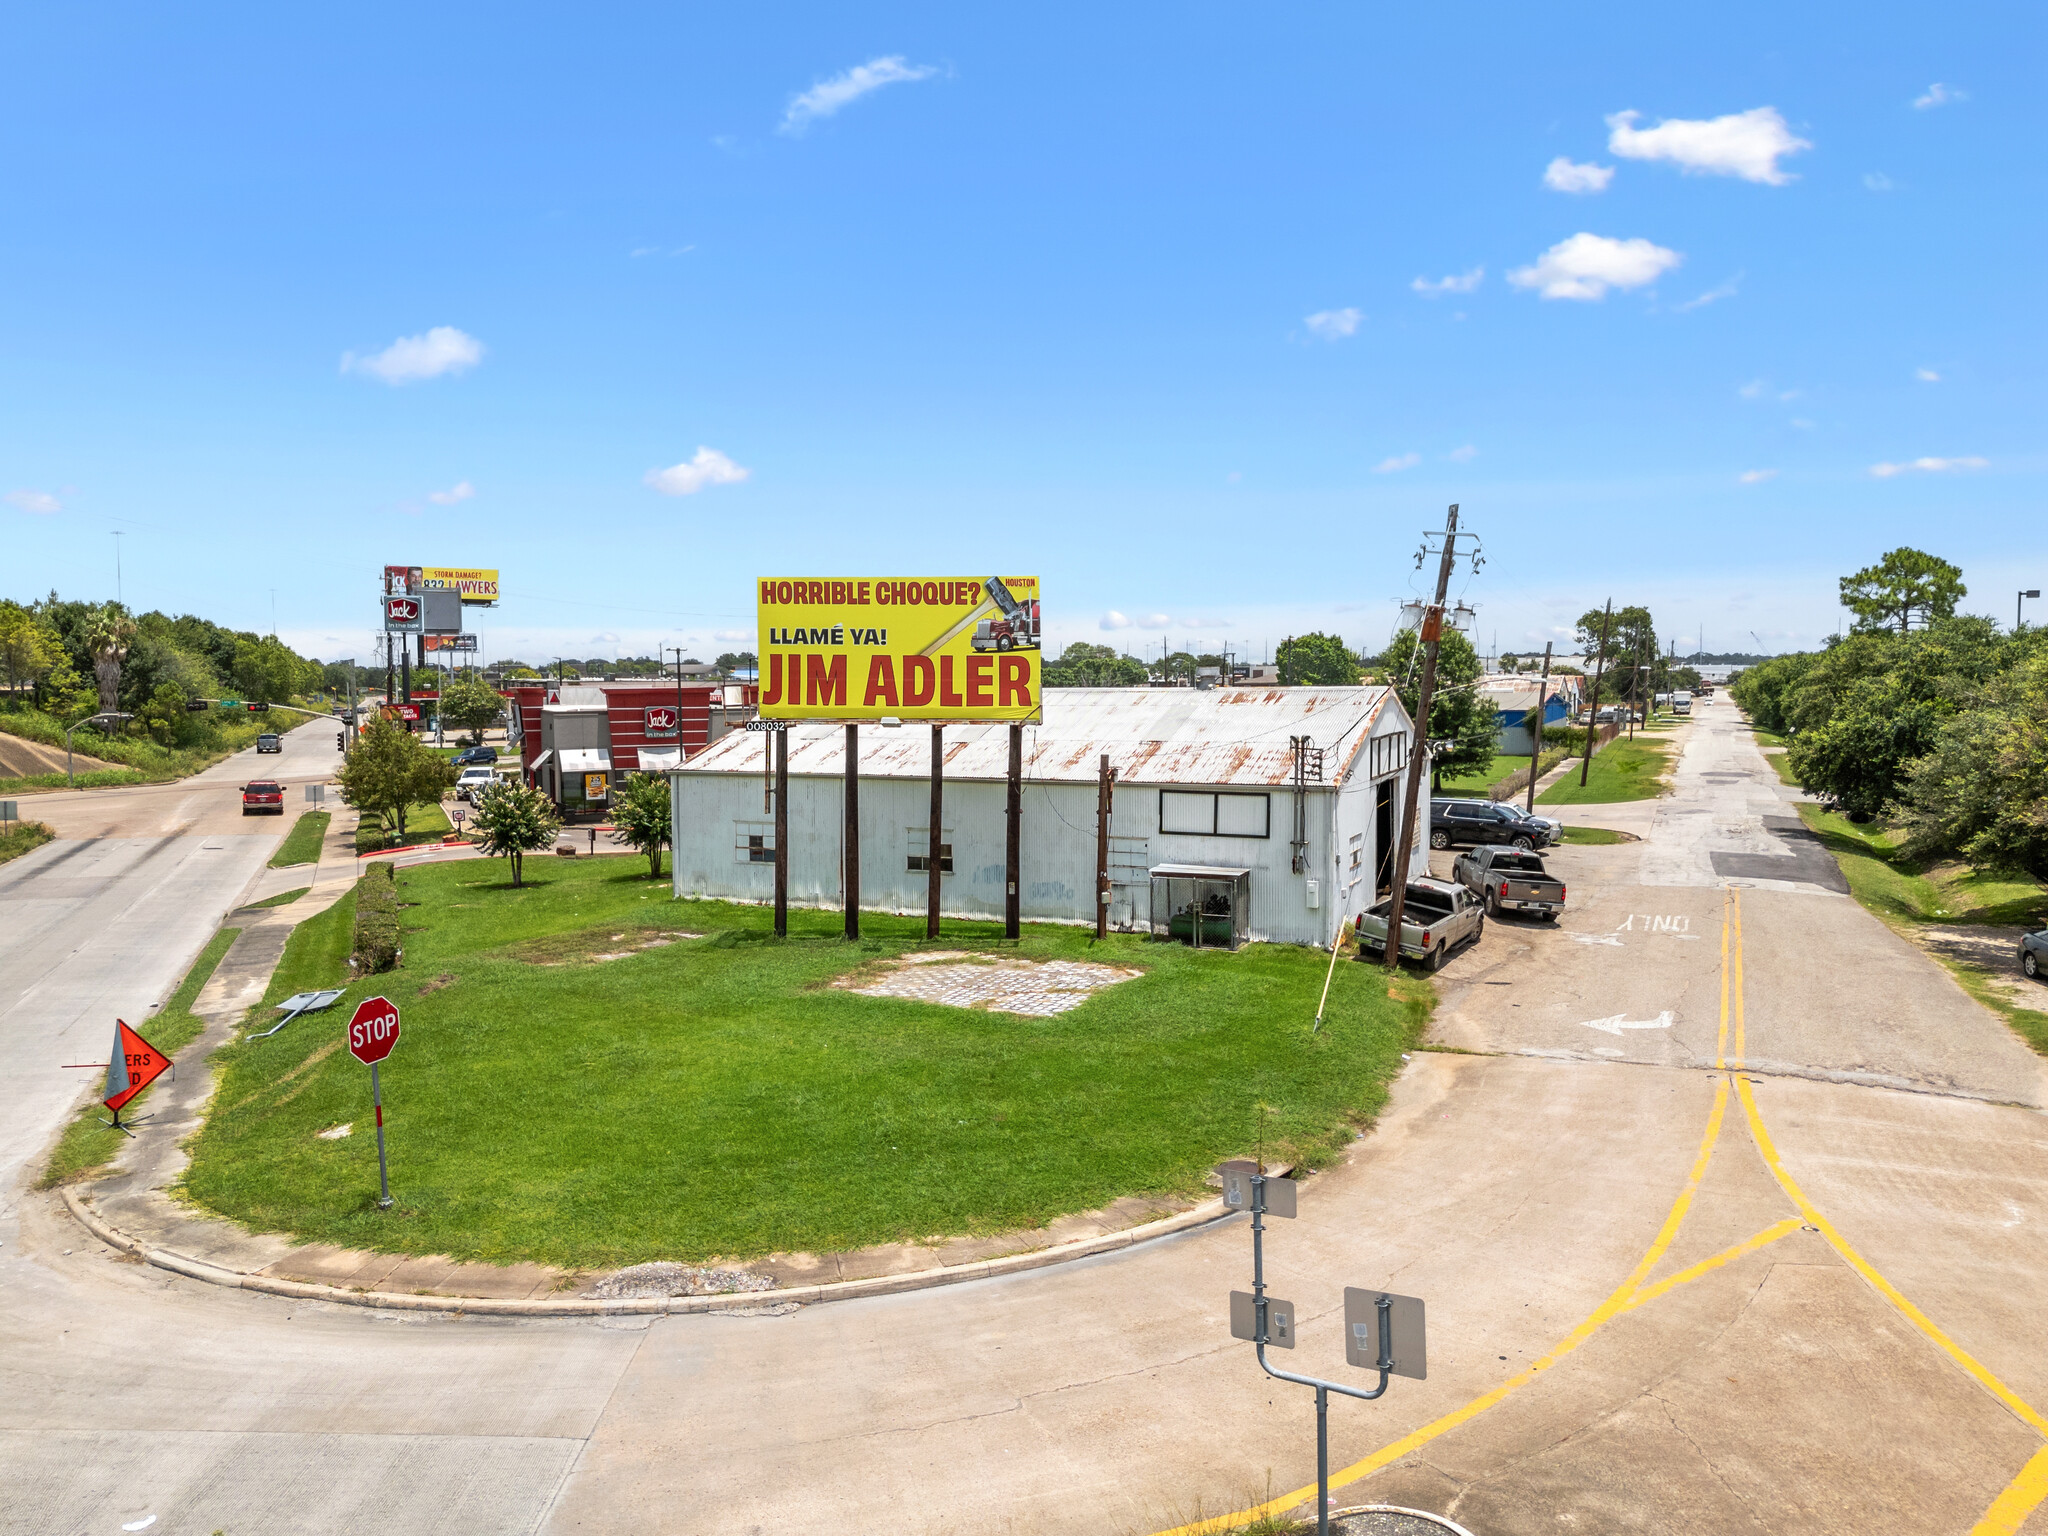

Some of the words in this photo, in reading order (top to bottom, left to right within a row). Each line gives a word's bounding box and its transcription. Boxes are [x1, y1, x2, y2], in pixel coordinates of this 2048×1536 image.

[434, 570, 454, 578] STORM
[455, 571, 482, 579] DAMAGE?
[1005, 578, 1036, 588] HOUSTON
[448, 580, 498, 595] LAWYERS
[761, 580, 871, 605] HORRIBLE
[876, 581, 982, 606] CHOQUE?
[388, 601, 418, 619] Jack
[769, 622, 844, 646] LLAMÉ
[850, 628, 887, 646] YA!
[762, 653, 848, 706] JIM
[863, 654, 1033, 707] ADLER
[647, 710, 675, 728] Jack
[746, 721, 786, 732] 008032
[1616, 914, 1690, 933] ONLY
[352, 1013, 396, 1048] STOP
